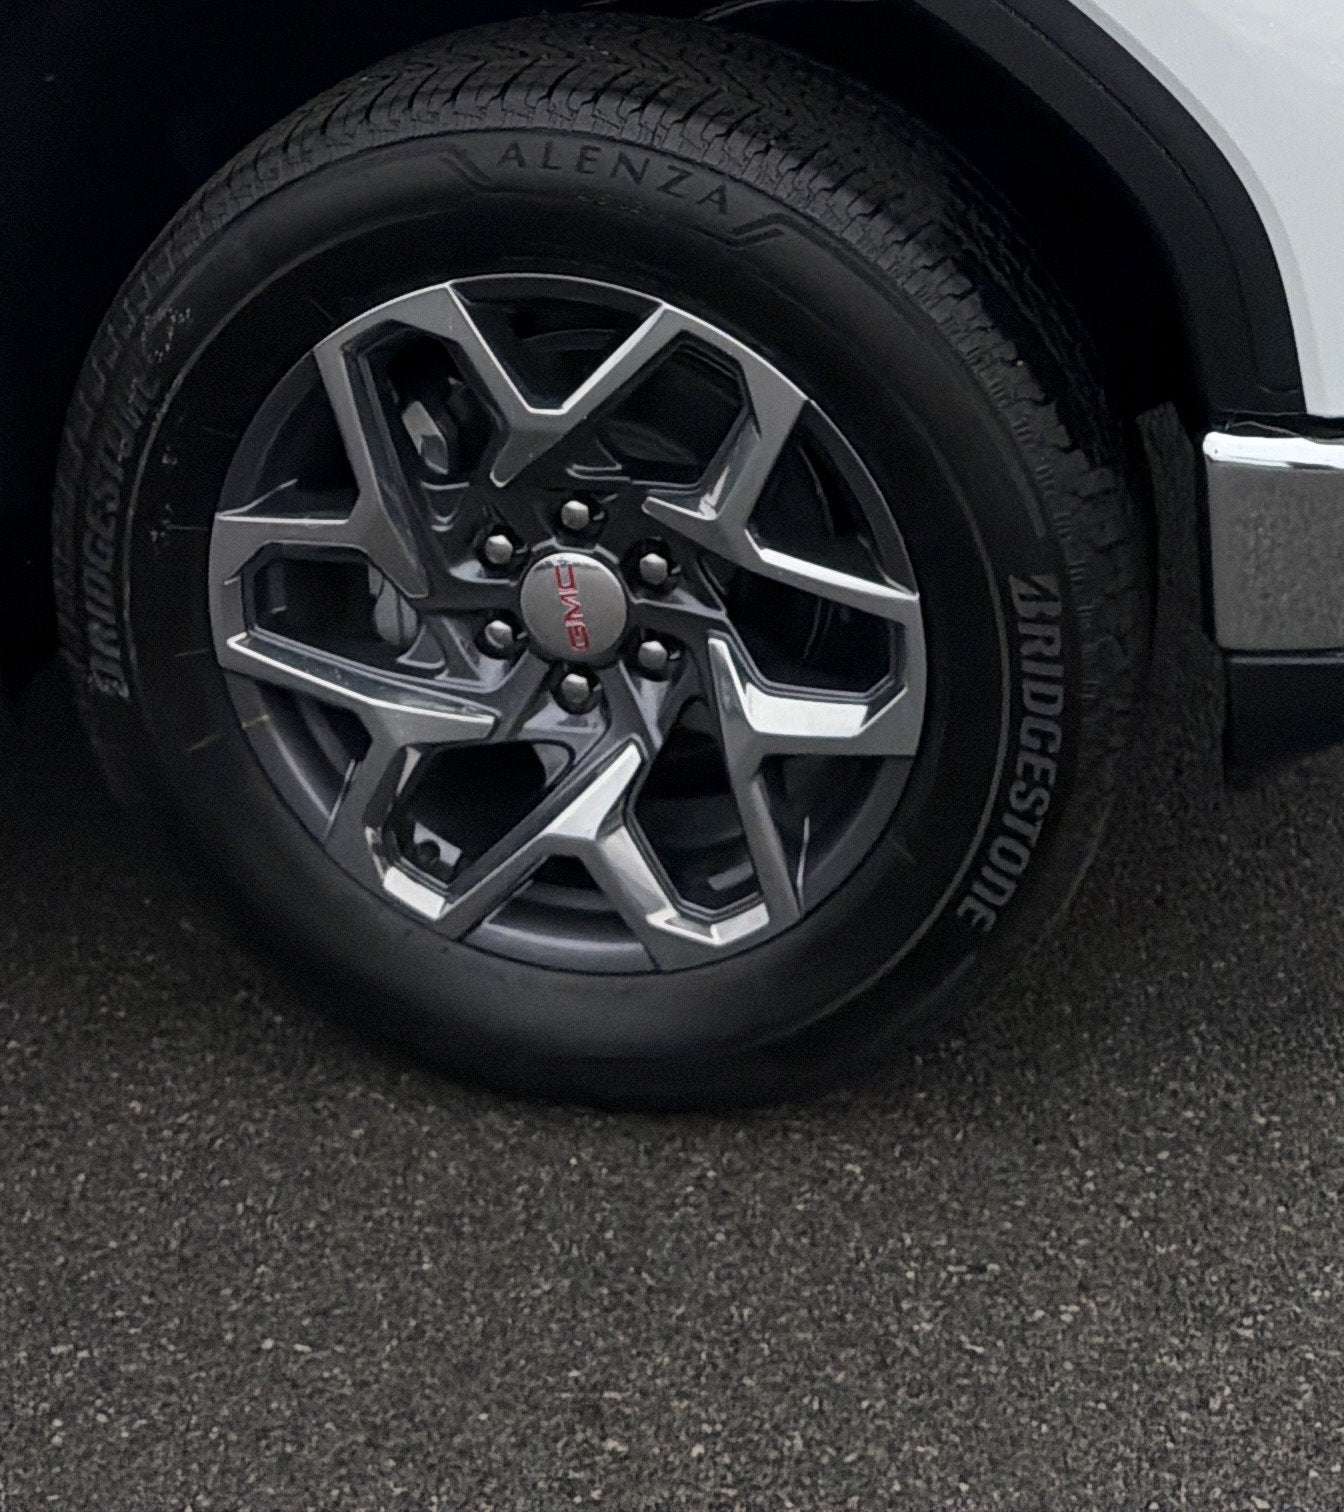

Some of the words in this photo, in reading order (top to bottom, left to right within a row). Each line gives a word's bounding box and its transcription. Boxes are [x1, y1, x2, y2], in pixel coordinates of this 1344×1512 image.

[497, 140, 729, 215] ALENZA
[554, 561, 592, 653] GMC
[956, 572, 1065, 933] BRIDGESTONE
